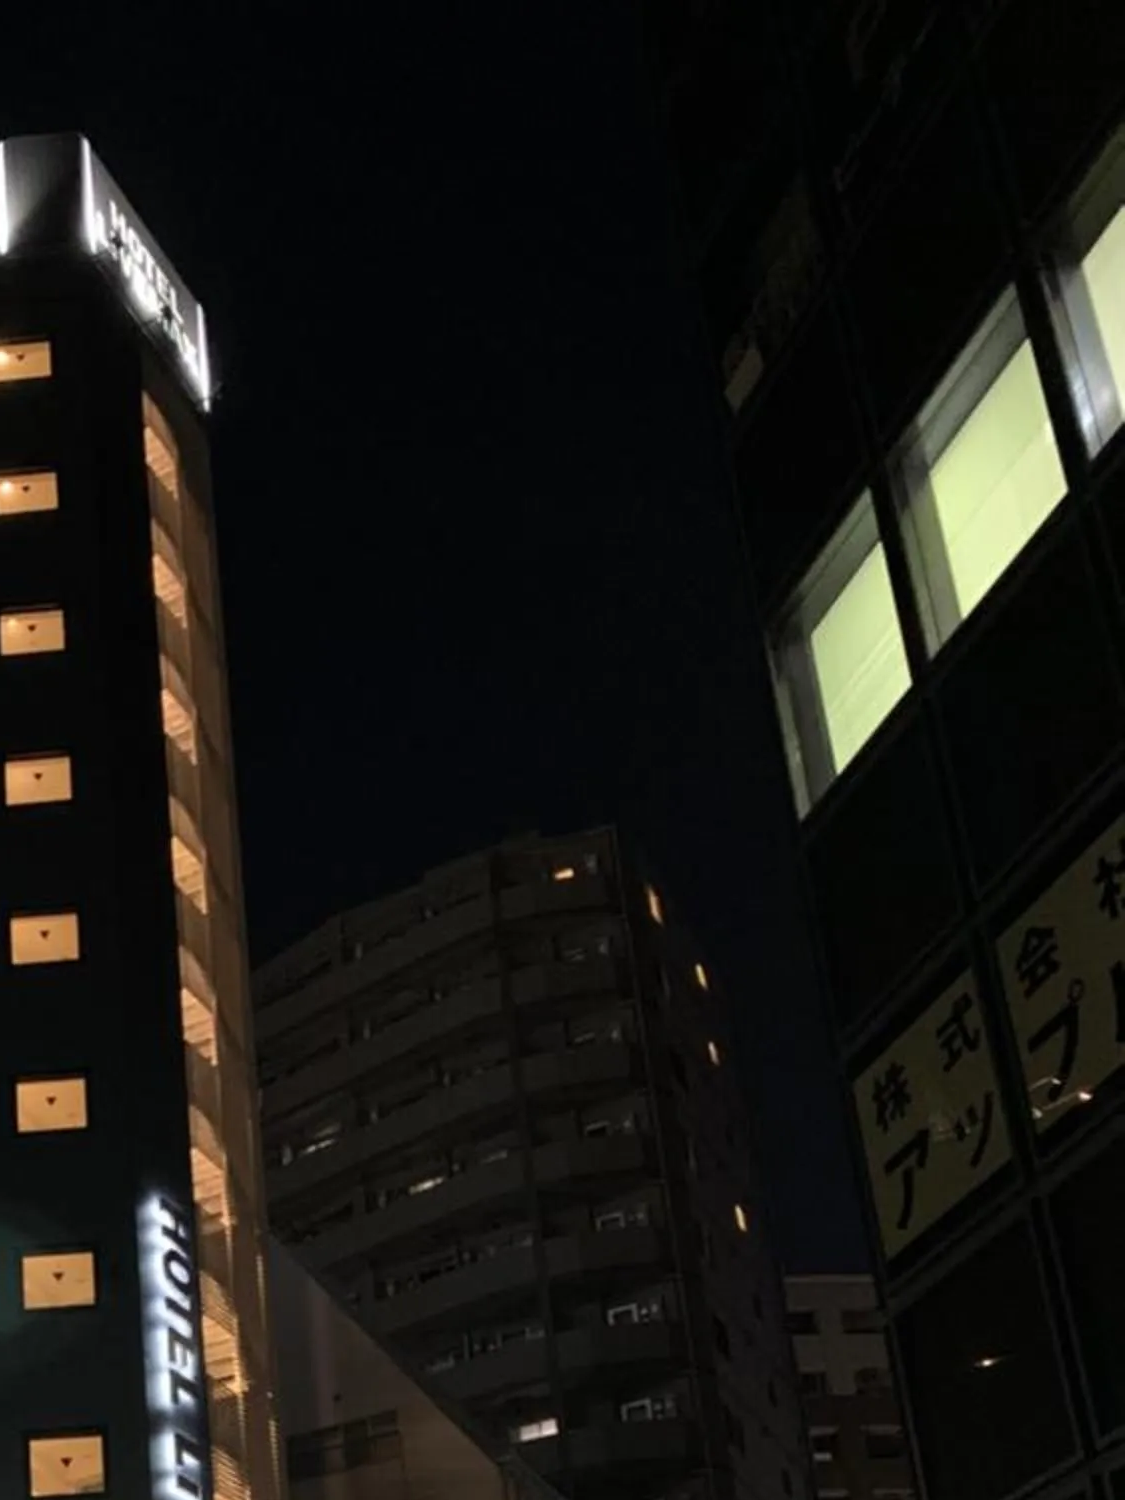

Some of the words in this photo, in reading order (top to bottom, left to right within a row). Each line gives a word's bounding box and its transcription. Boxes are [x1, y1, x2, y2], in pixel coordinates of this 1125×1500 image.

[883, 958, 1125, 1231] アップ
[159, 1194, 203, 1410] HOTEL
